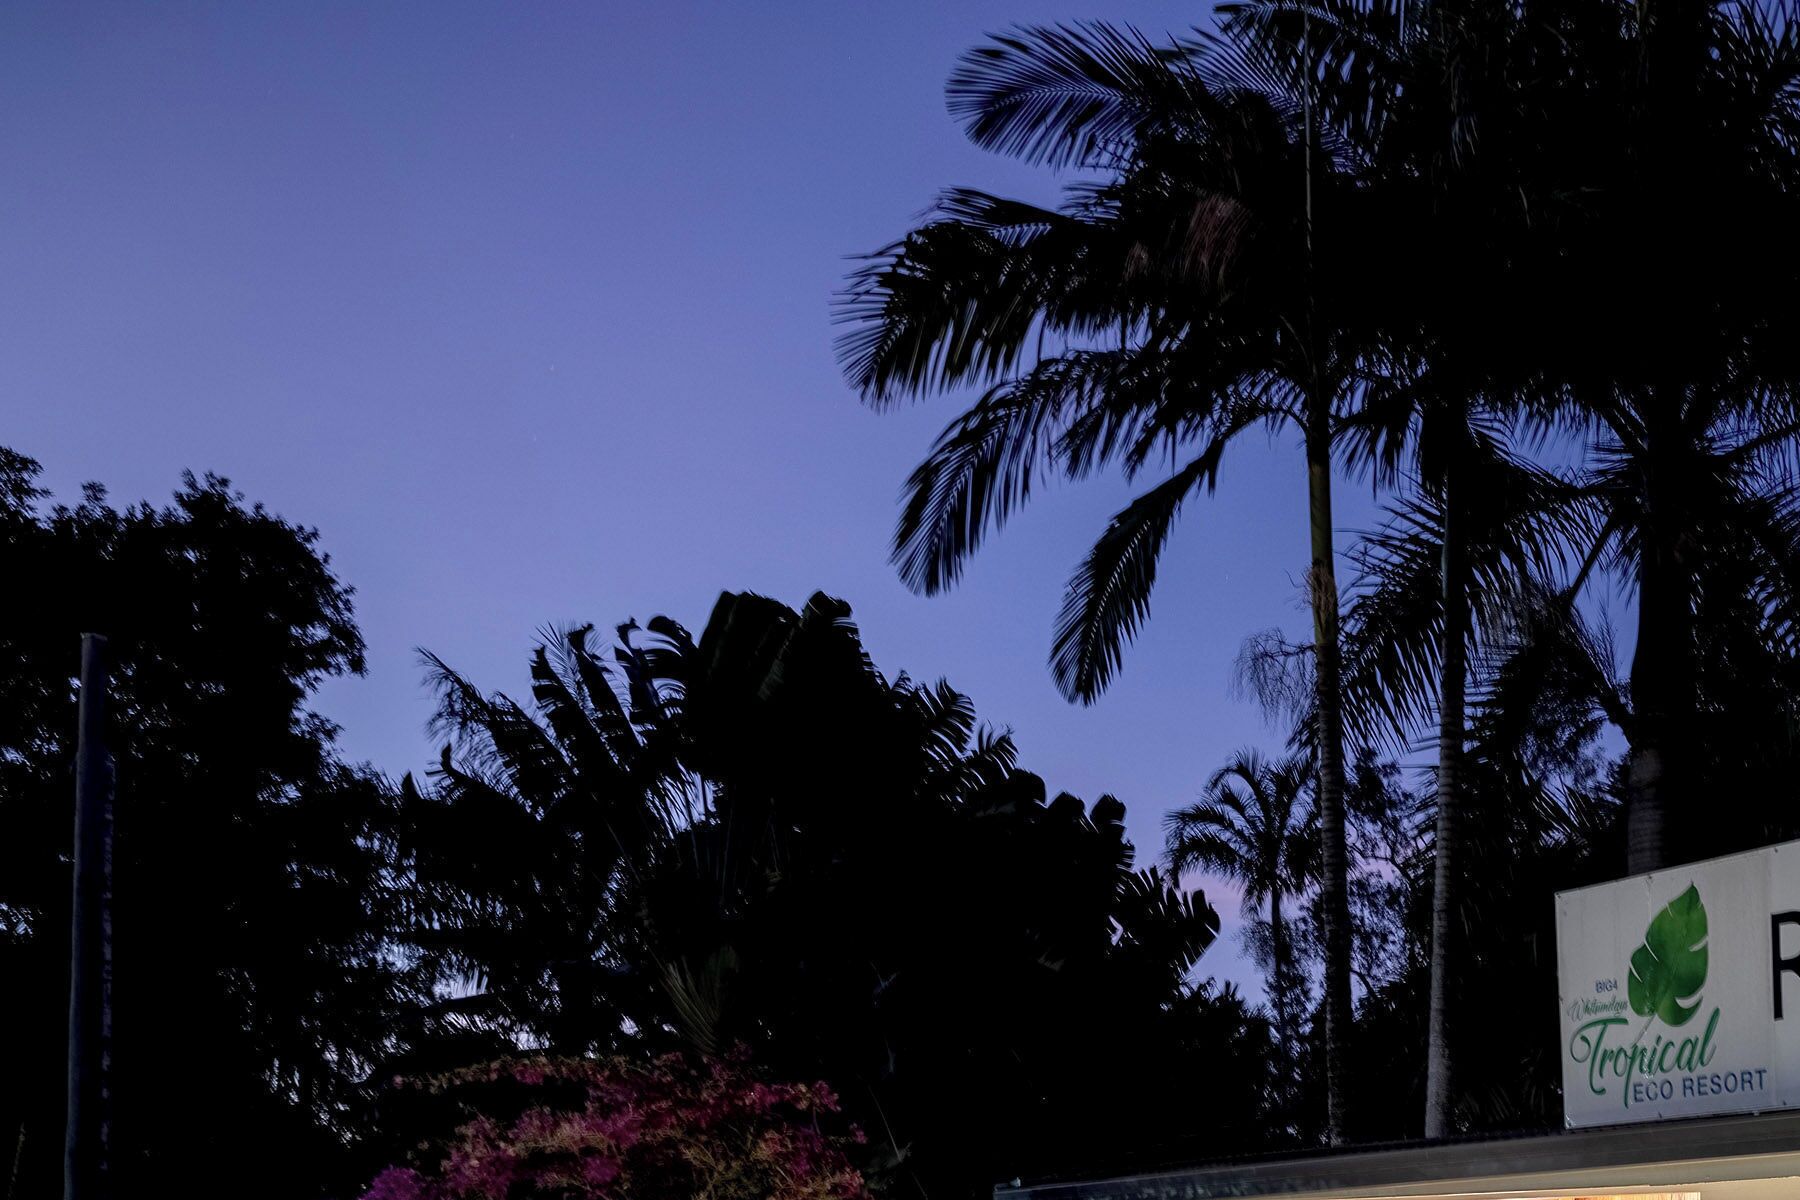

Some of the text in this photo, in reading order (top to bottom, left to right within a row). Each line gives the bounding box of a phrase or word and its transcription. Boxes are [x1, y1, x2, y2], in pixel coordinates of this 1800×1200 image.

[1595, 979, 1618, 993] BIG4
[1570, 1007, 1720, 1109] Tropical
[1633, 1068, 1768, 1102] ECO RESORT
